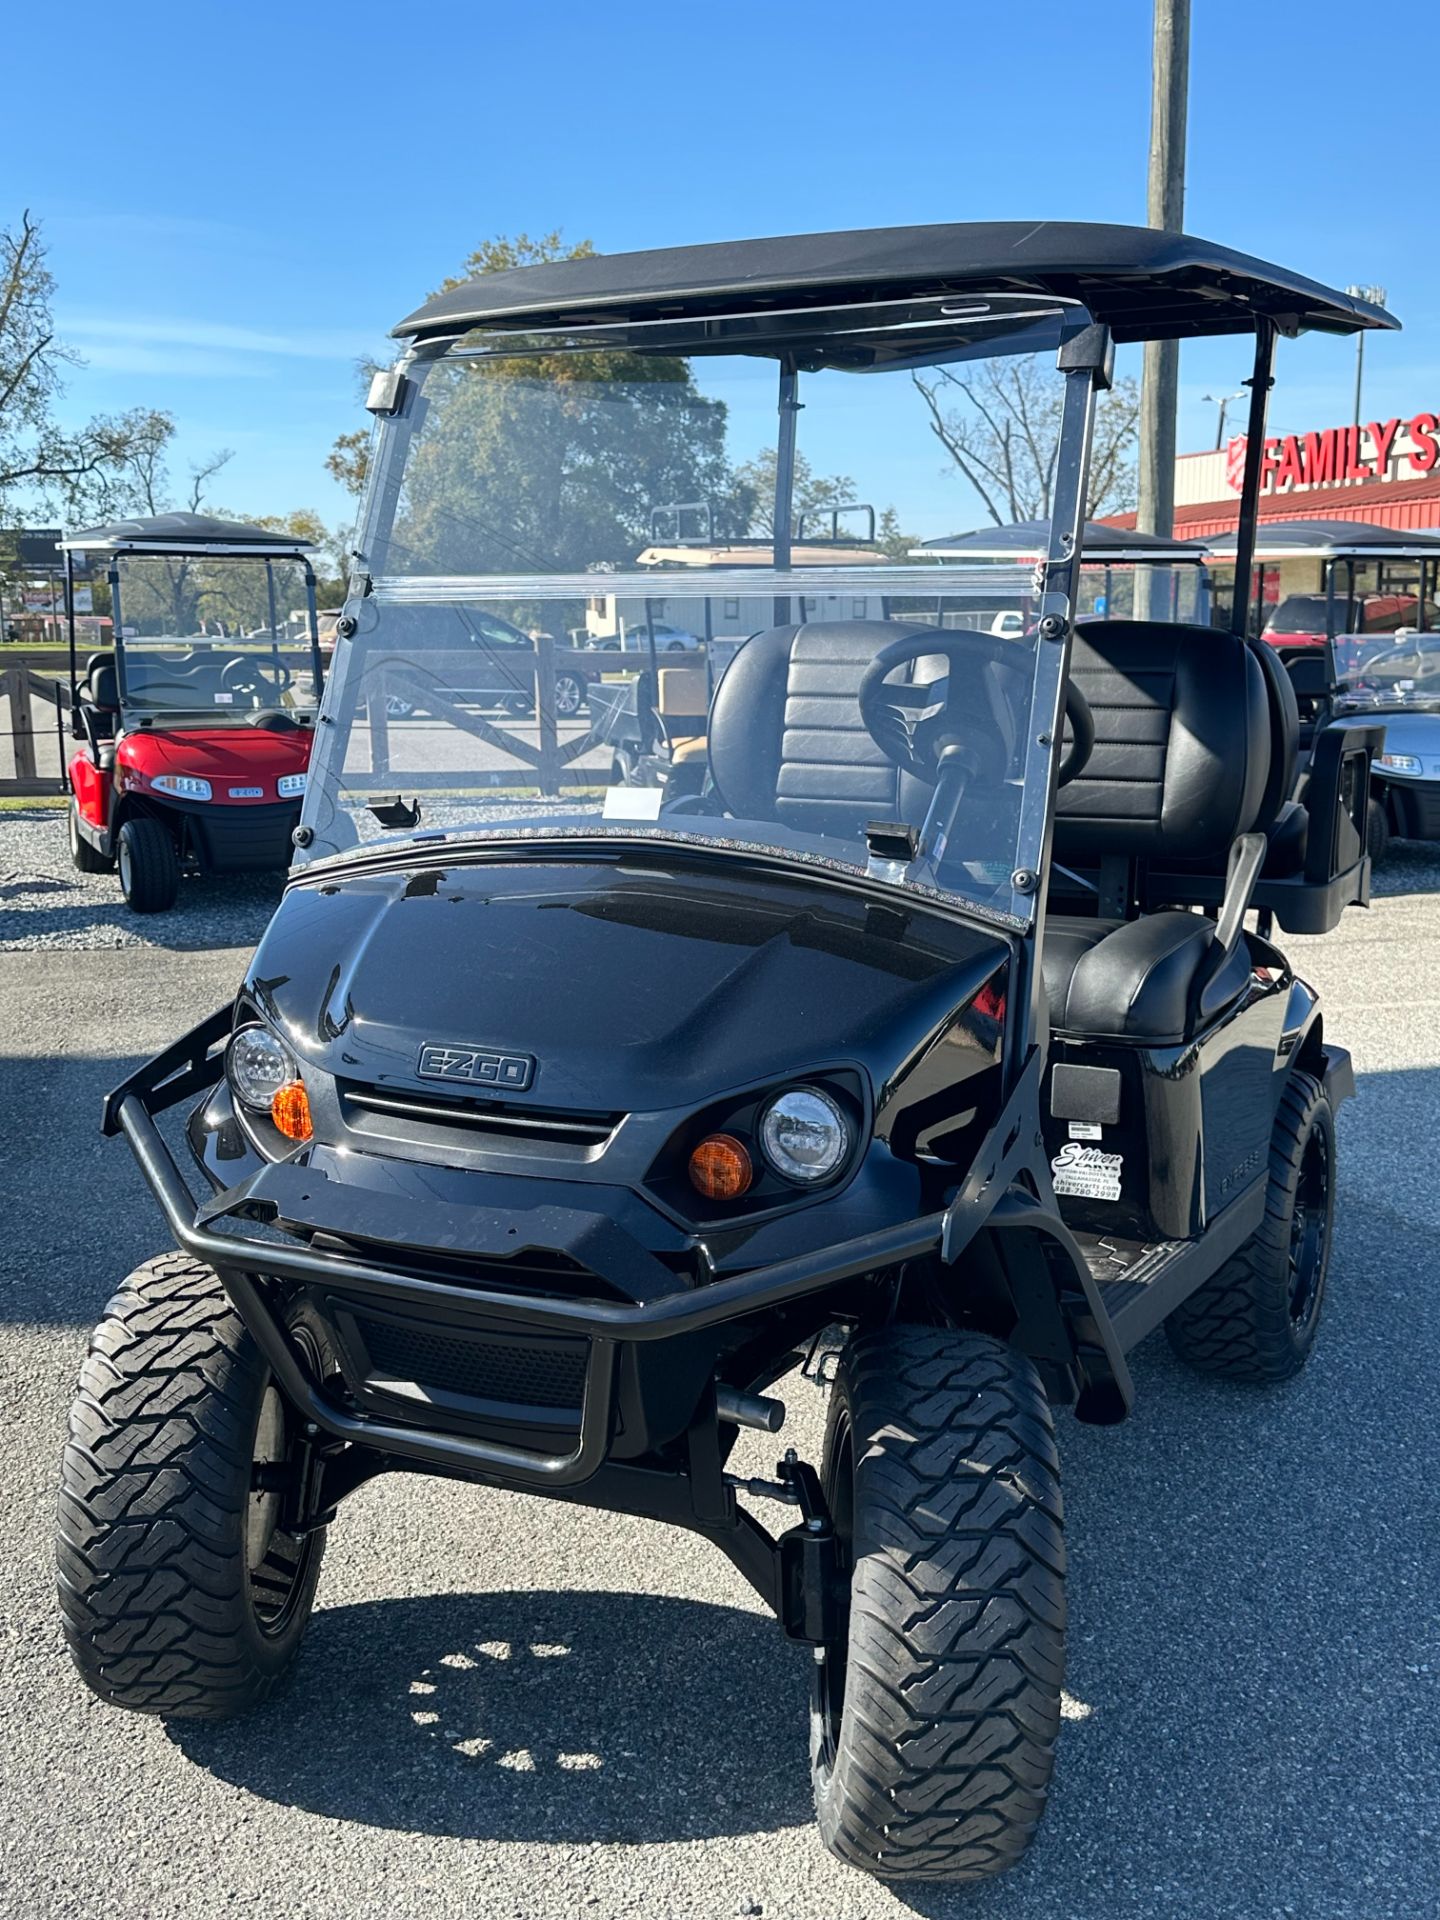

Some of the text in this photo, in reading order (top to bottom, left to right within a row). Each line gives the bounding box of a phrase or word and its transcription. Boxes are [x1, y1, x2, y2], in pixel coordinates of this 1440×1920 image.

[1260, 412, 1440, 490] FAMILY S
[419, 1047, 528, 1085] EZGO
[1054, 1145, 1121, 1168] Shiver
[1075, 1162, 1118, 1171] CARTS
